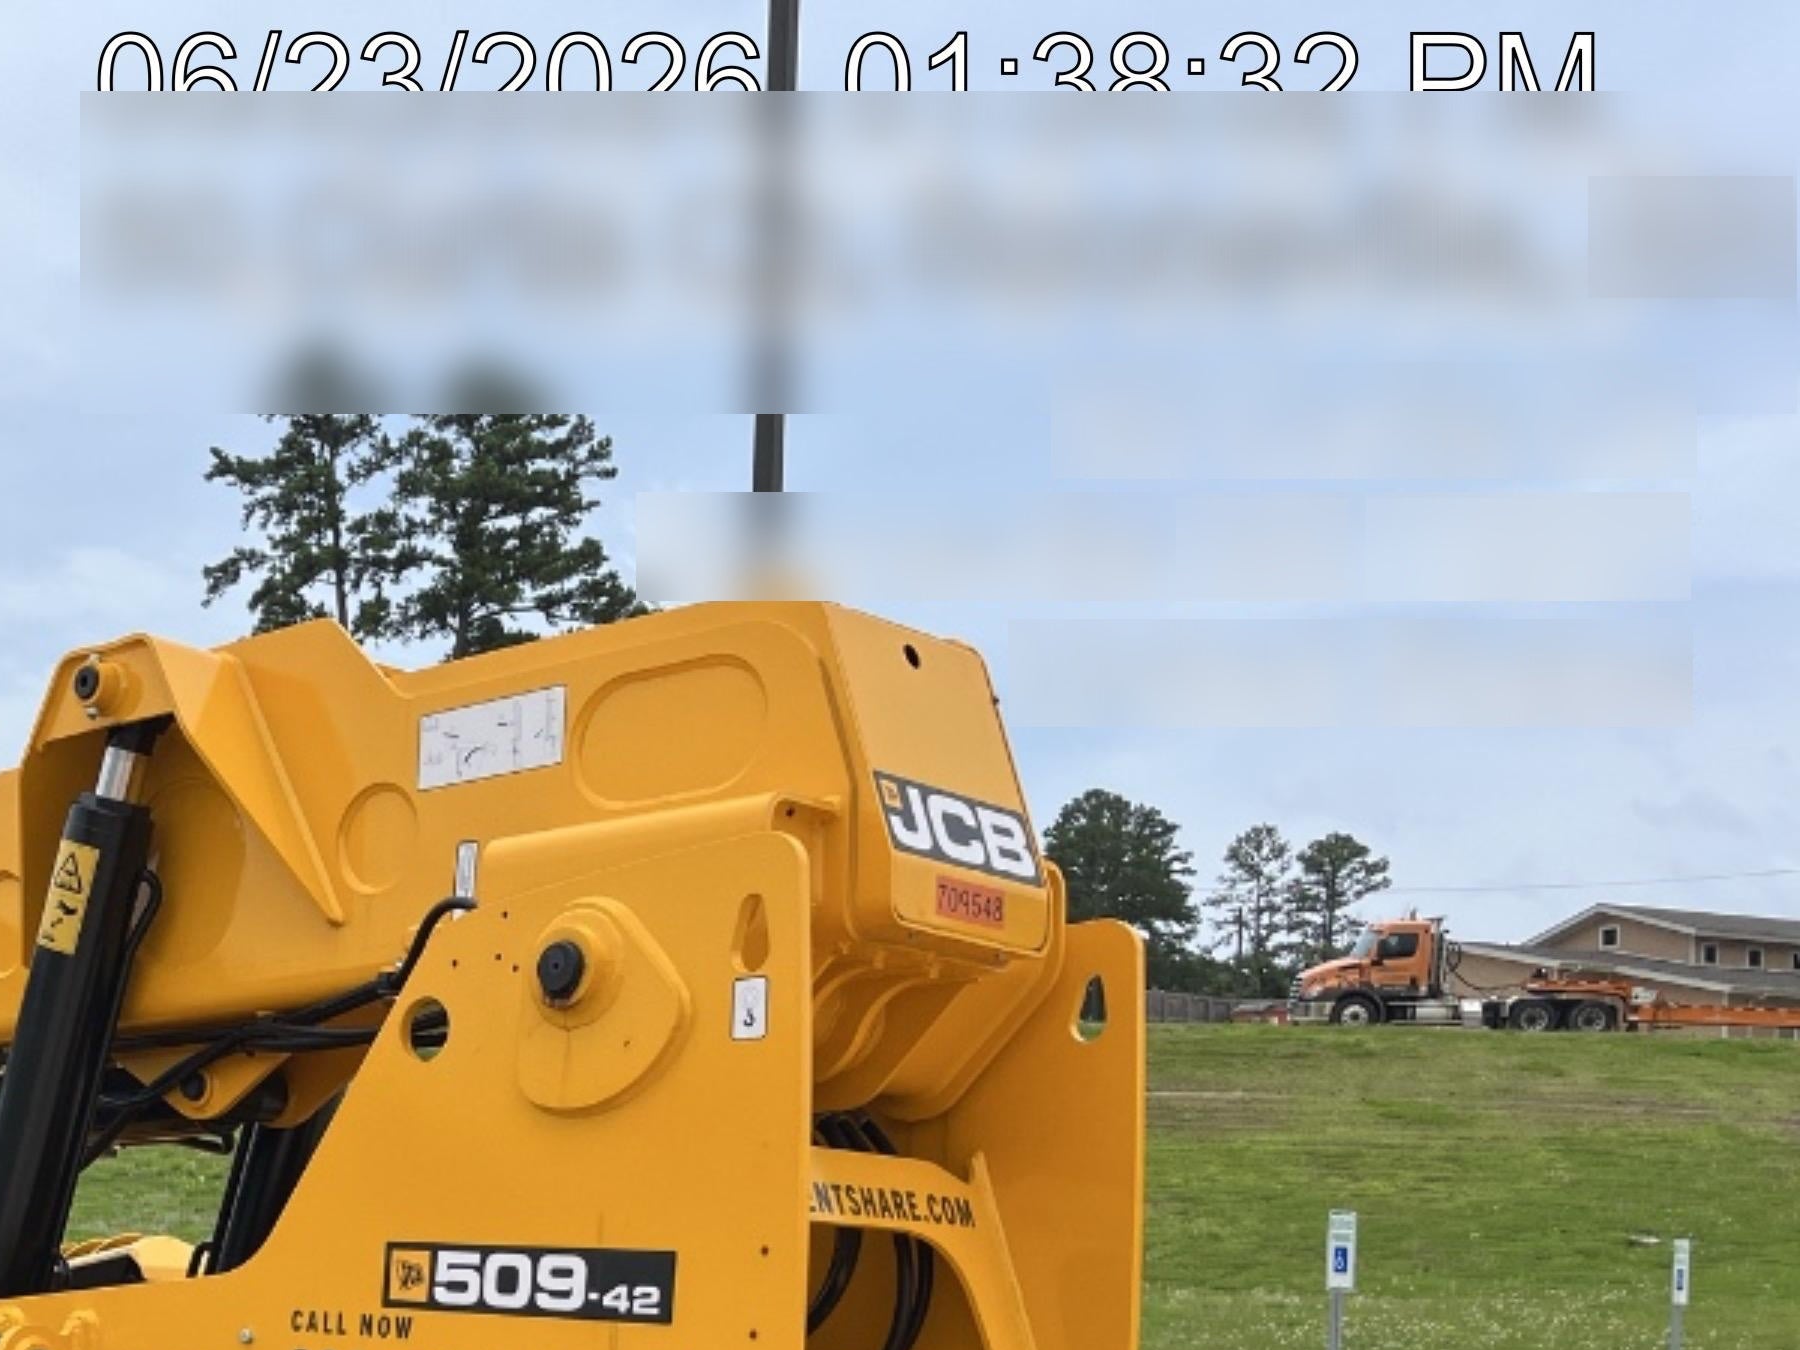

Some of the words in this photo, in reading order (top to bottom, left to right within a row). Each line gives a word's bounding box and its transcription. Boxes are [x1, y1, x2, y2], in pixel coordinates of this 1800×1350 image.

[888, 785, 1037, 877] JCB
[937, 884, 1004, 921] 709548
[809, 1181, 977, 1228] NTSHARE.COM
[433, 1250, 661, 1315] 509-42
[291, 1310, 347, 1336] CALL
[359, 1314, 413, 1339] NOW
